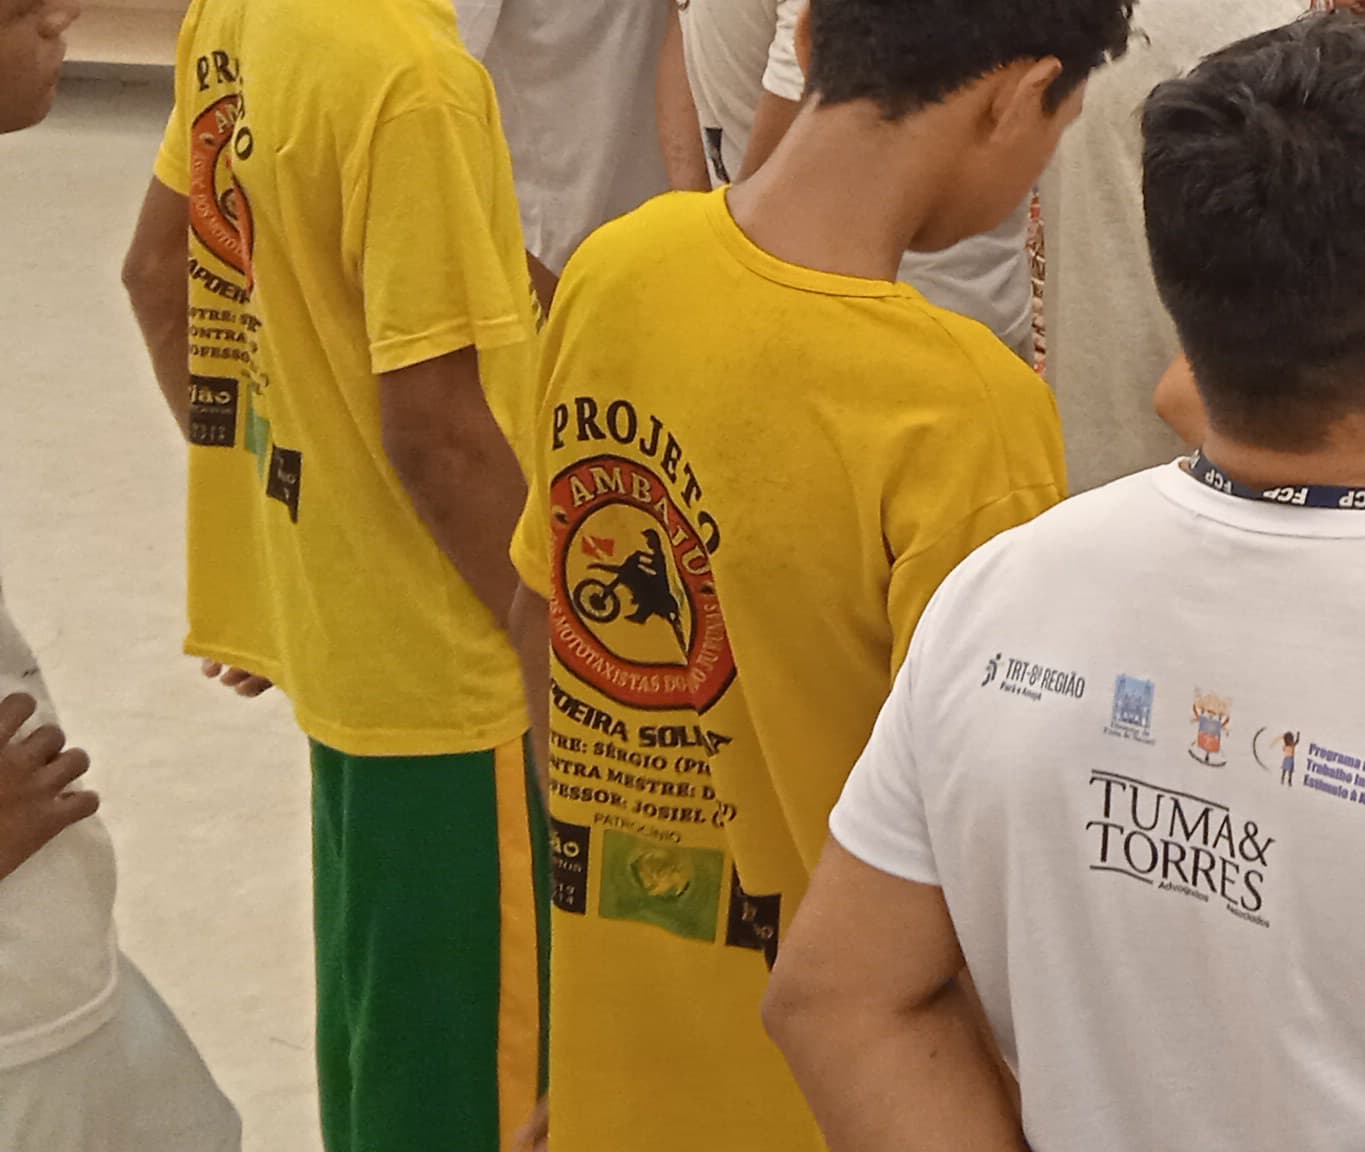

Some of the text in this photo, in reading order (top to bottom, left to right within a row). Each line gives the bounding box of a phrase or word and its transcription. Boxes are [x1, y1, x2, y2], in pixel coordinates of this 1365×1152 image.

[552, 396, 721, 555] PROJETO
[567, 465, 711, 576] AMBAJU
[1040, 666, 1086, 699] REGIÃO
[1306, 758, 1353, 782] Trabalho
[1308, 743, 1361, 770] Programa
[606, 767, 696, 799] MESTRE:
[632, 798, 706, 825] JOSIEL
[1086, 821, 1264, 912] TORRES
